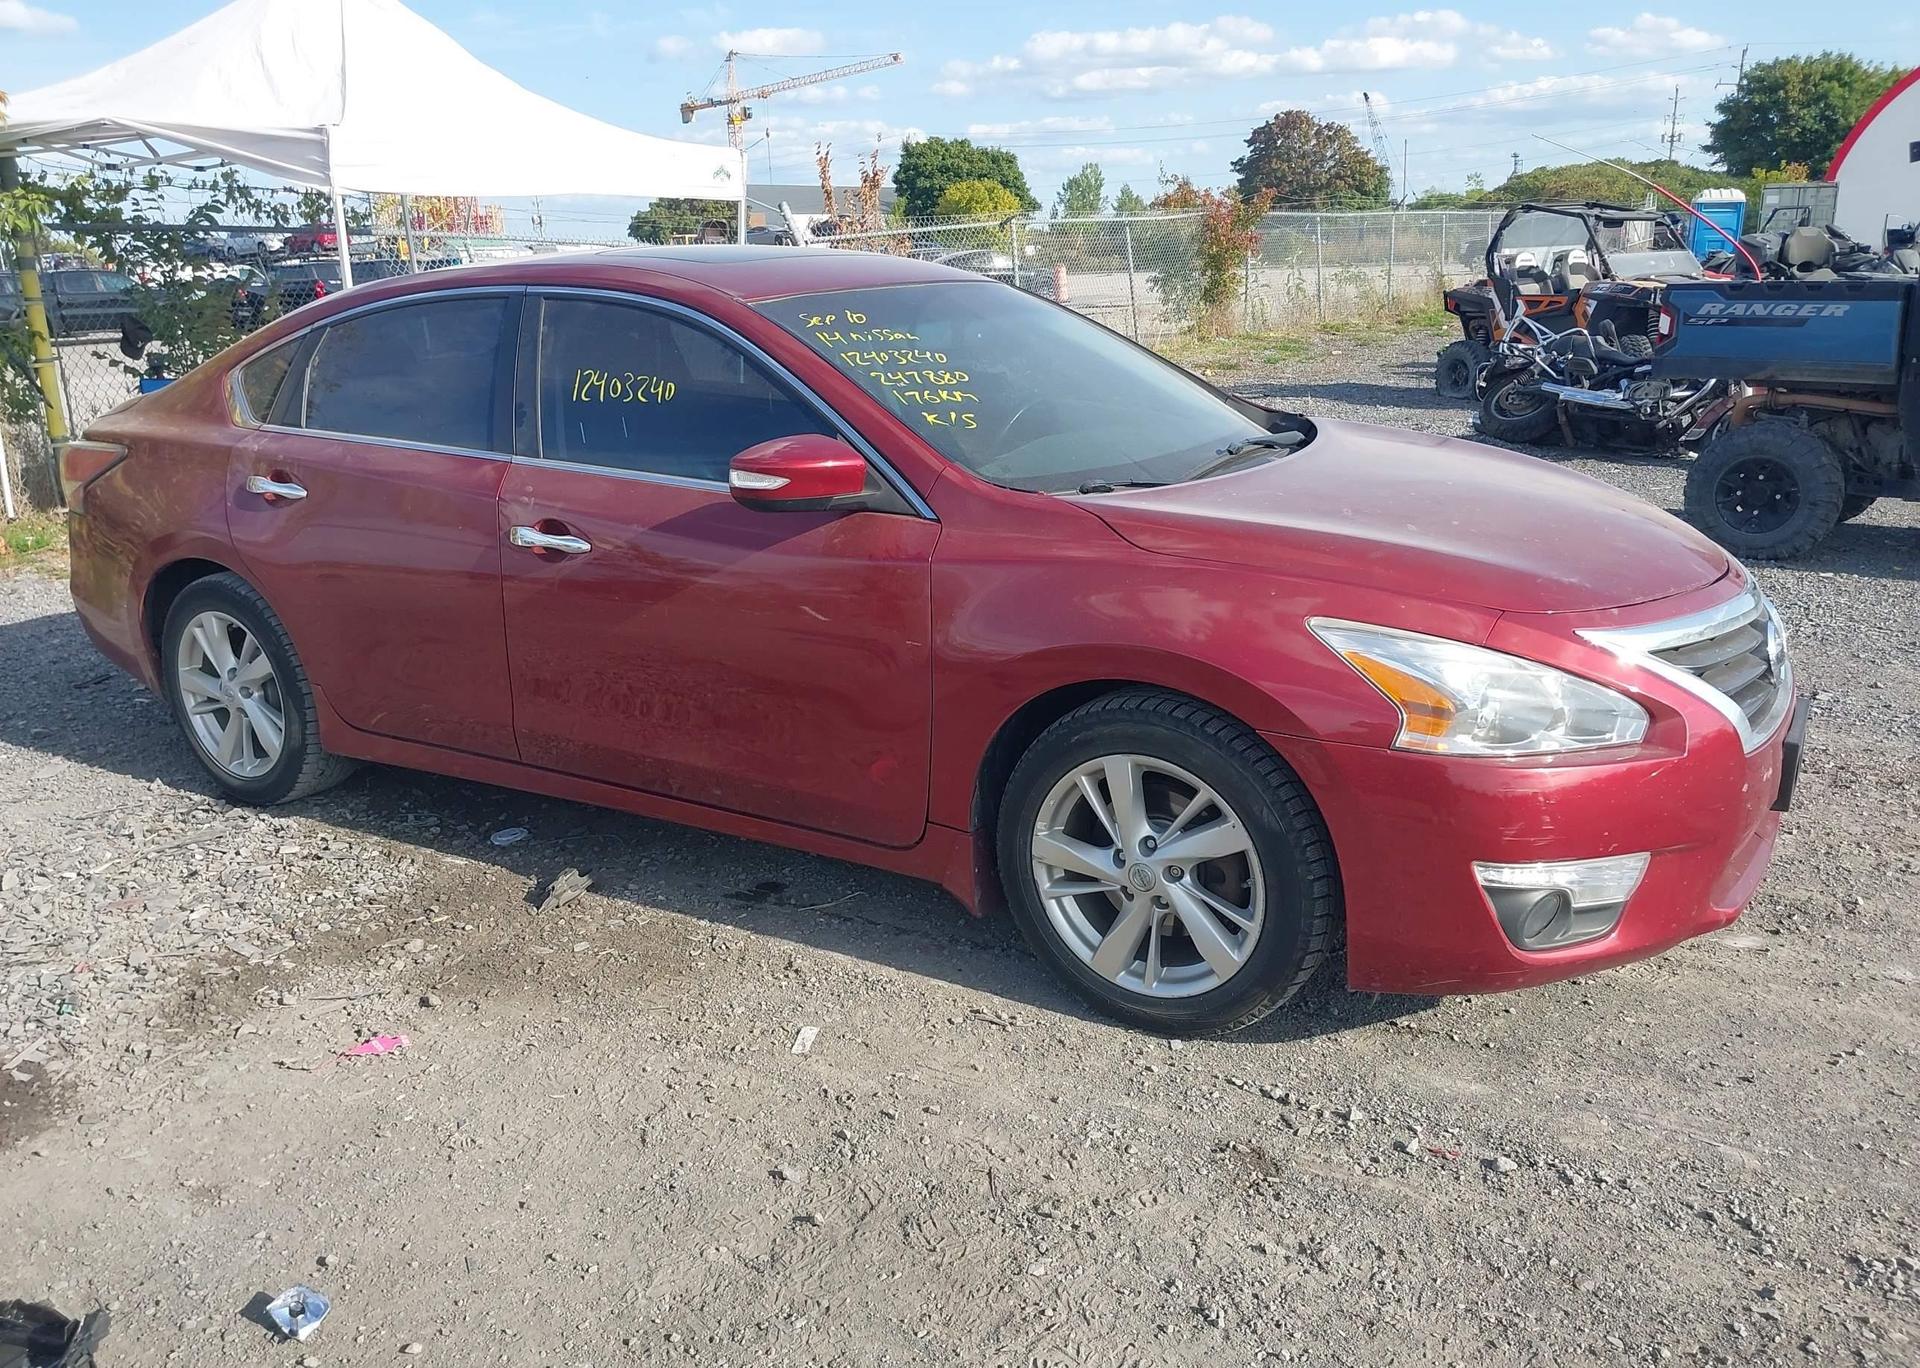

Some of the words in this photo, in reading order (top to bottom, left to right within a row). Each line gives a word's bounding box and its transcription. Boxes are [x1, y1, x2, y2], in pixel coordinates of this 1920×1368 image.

[844, 309, 867, 324] 10
[1697, 302, 1850, 317] RANGER
[1685, 317, 1729, 326] SP
[815, 331, 848, 348] 14
[840, 349, 948, 367] 12403240
[572, 368, 676, 404] 12403240
[870, 370, 970, 386] 247880
